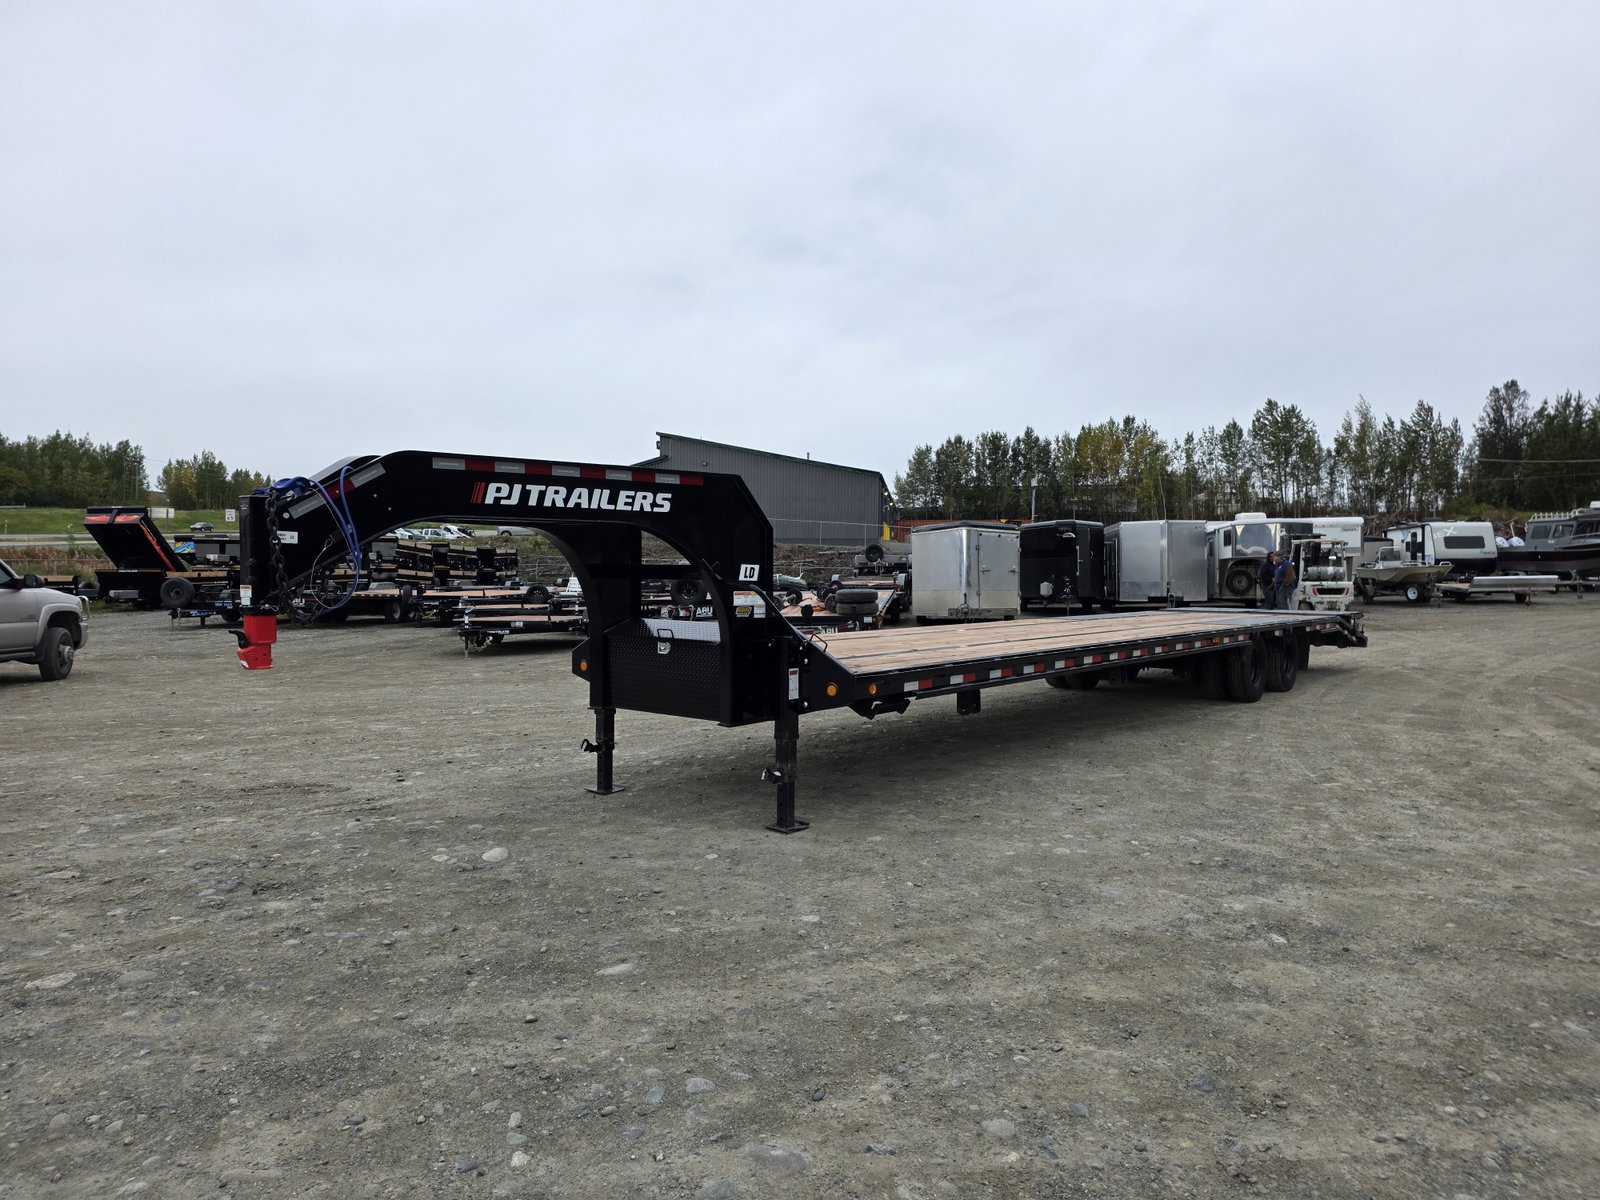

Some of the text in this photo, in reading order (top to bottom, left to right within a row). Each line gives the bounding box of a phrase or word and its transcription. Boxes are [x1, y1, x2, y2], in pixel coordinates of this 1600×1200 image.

[485, 482, 672, 512] PJ TRAILERS
[744, 566, 756, 579] LD
